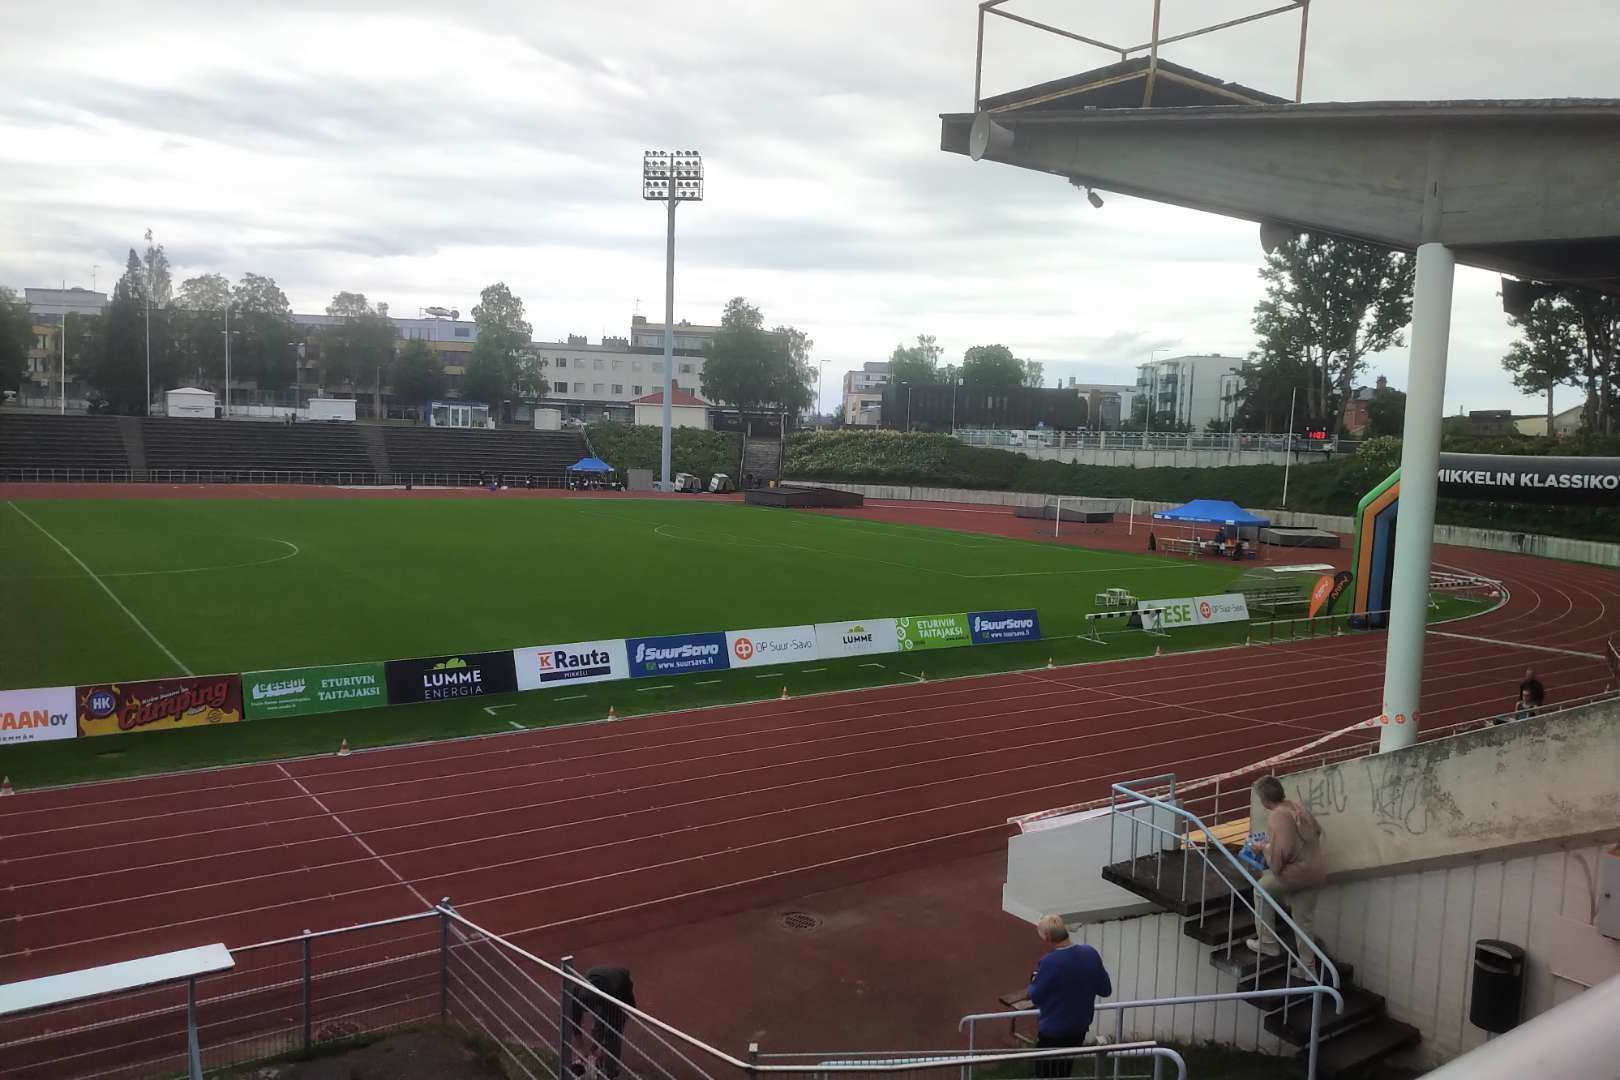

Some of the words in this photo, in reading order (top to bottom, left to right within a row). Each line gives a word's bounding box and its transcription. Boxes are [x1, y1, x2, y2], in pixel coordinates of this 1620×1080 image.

[1520, 473, 1620, 490] KLASSIKO
[917, 618, 955, 629] ETURIVIN
[843, 634, 872, 644] LUMME
[919, 627, 962, 638] TAITAJAKSI
[756, 641, 768, 653] OP
[554, 650, 610, 669] Rauta
[322, 675, 375, 688] ETURIVIN
[424, 670, 482, 688] LUMME
[318, 687, 380, 701] TAITAJAKSI
[425, 686, 483, 699] ENERGIA
[93, 697, 111, 710] HK
[118, 681, 228, 731] Camping
[0, 709, 49, 730] AAN
[50, 713, 68, 726] OY
